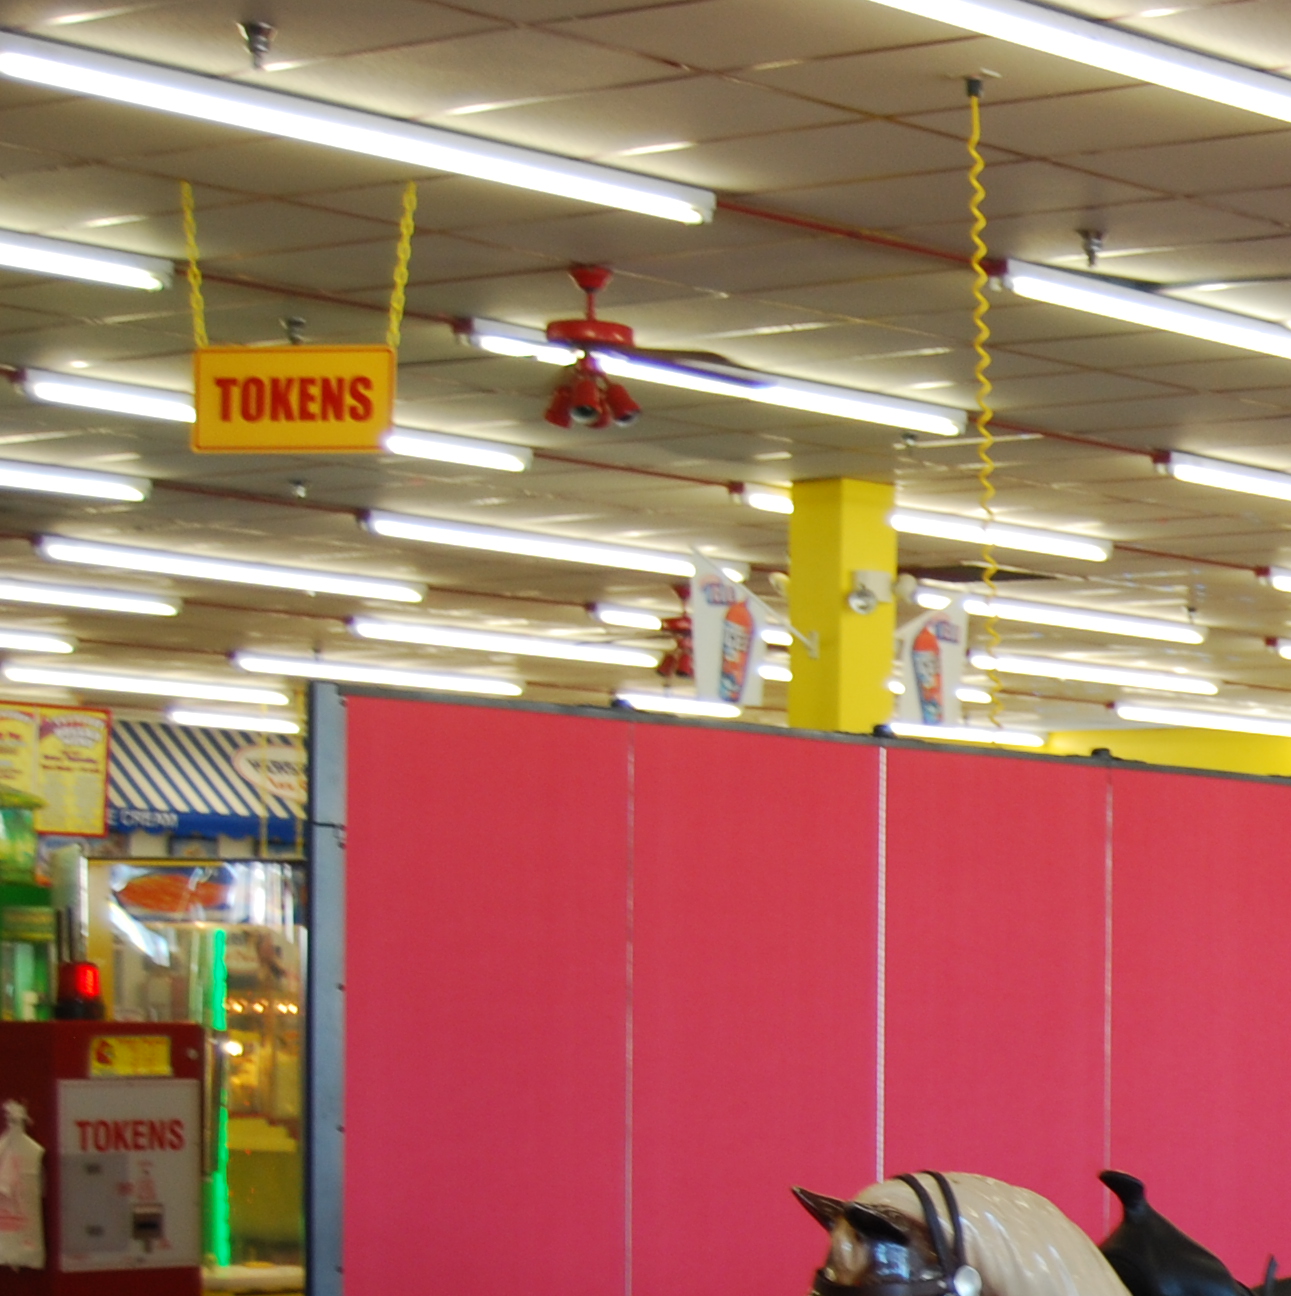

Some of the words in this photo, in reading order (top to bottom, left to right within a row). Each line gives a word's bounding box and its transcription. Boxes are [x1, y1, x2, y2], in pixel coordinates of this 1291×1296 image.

[214, 376, 374, 423] TOKENS
[120, 810, 179, 829] CREAM
[74, 1119, 187, 1152] TOKENS
